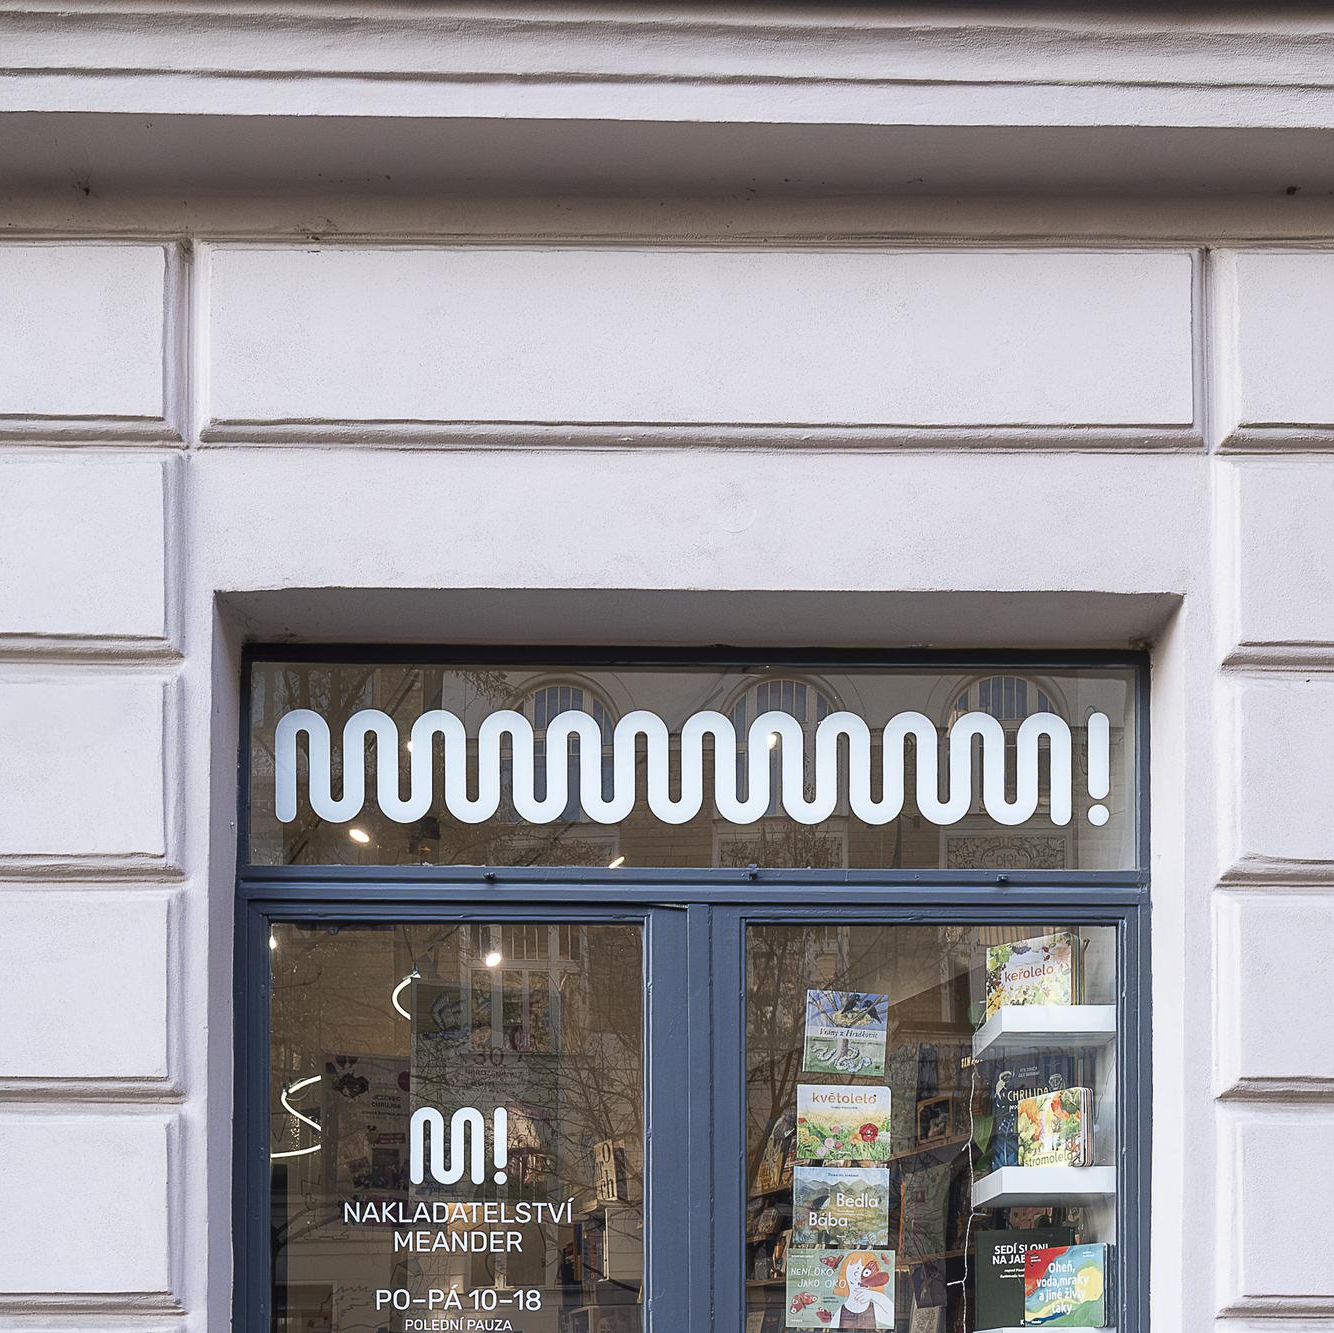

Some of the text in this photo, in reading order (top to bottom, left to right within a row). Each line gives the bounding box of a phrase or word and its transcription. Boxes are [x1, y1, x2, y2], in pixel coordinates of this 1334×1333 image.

[1004, 964, 1054, 983] keřolelo
[812, 1092, 877, 1105] květolelo
[410, 1106, 508, 1185] M!
[836, 1192, 879, 1208] Bedla
[343, 1197, 575, 1224] NAKLADATELSTVÍ
[809, 1211, 848, 1227] Bába
[394, 1230, 523, 1253] MEANDER
[994, 1242, 1017, 1255] SEDÍ
[992, 1255, 1007, 1265] NA
[1048, 1260, 1076, 1274] Oheň,
[790, 1265, 834, 1276] NENÍ OKO
[797, 1279, 847, 1288] JAKO OKO
[1038, 1291, 1044, 1301] a
[1045, 1289, 1063, 1302] jiné
[1052, 1302, 1073, 1315] taky
[404, 1317, 513, 1331] POLEDNÍ PAUZA
